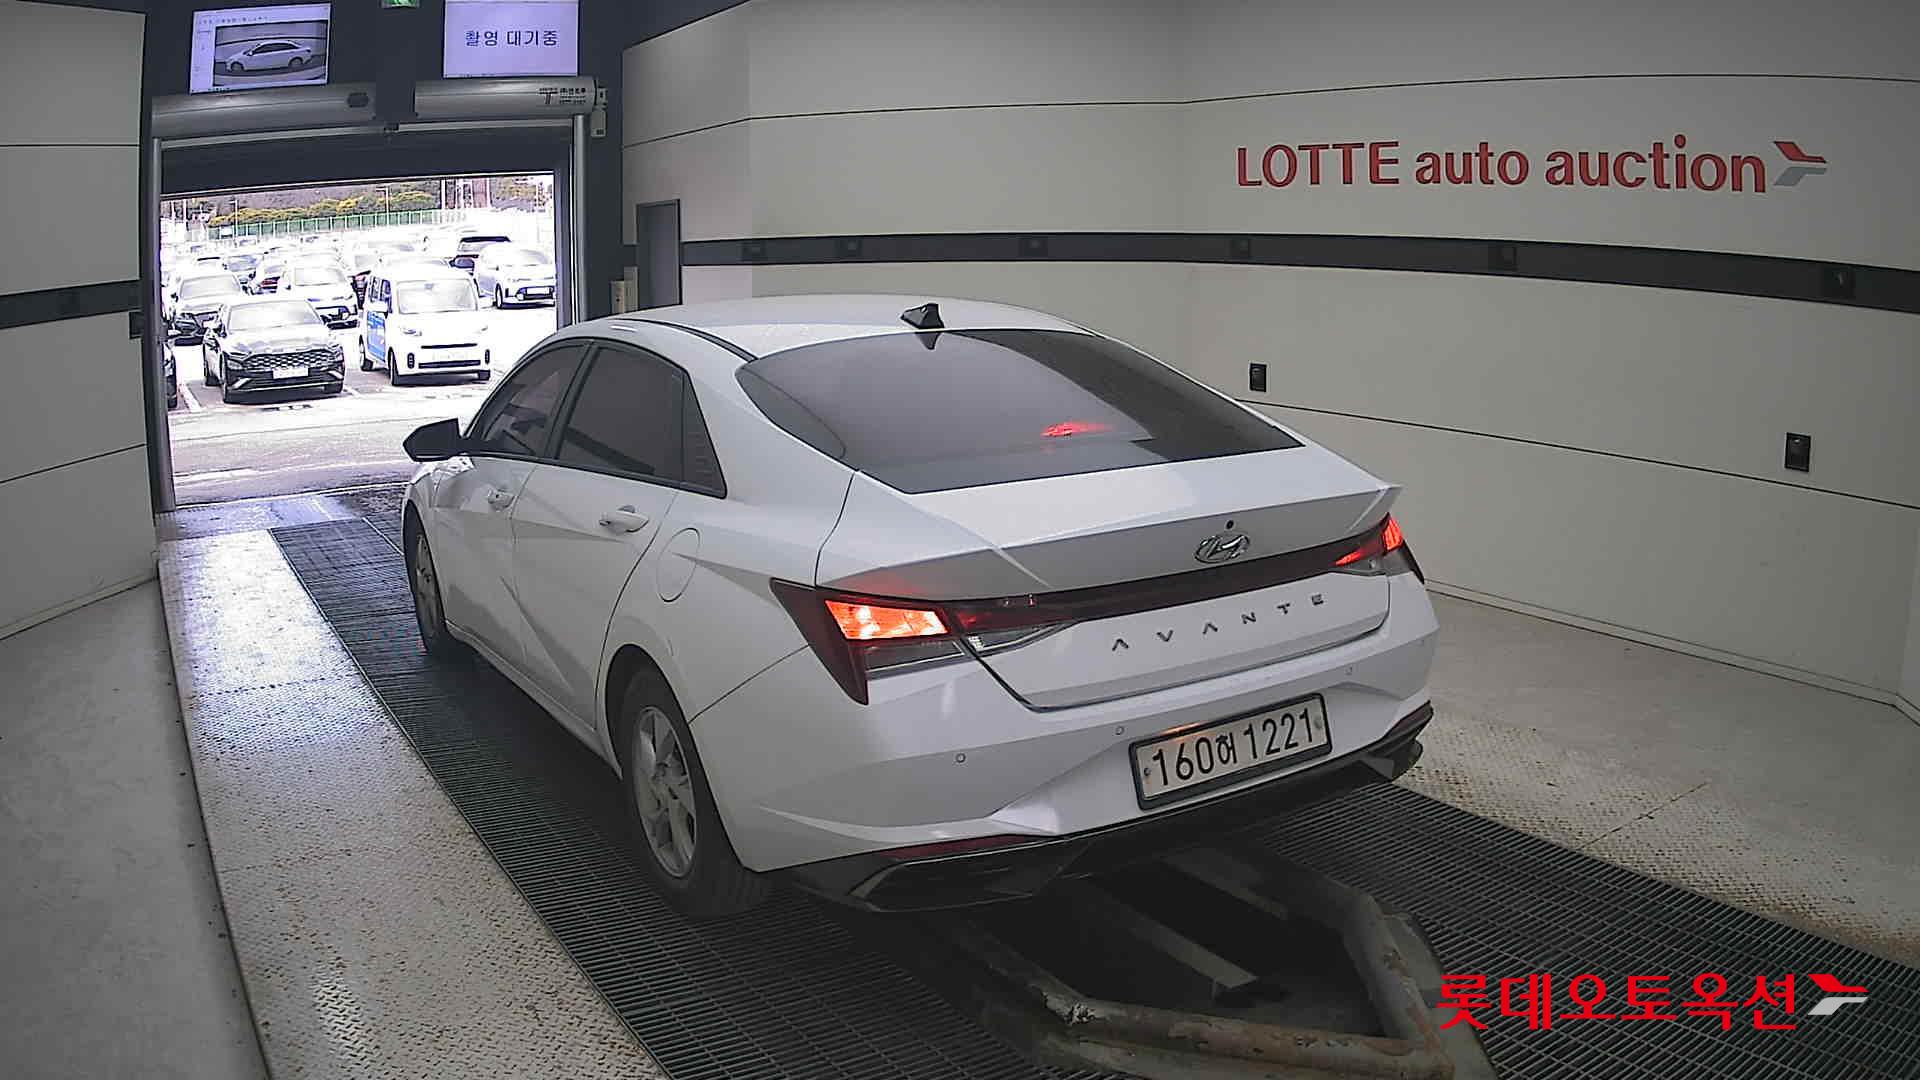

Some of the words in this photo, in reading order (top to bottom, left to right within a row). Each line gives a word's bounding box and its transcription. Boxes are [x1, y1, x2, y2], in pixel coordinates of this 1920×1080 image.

[466, 30, 498, 47] 촬영
[506, 30, 558, 46] 대기중
[1237, 141, 1400, 187] LOTTE
[1414, 141, 1529, 186] auto
[1545, 134, 1765, 193] auction
[1112, 594, 1325, 651] AVANTE
